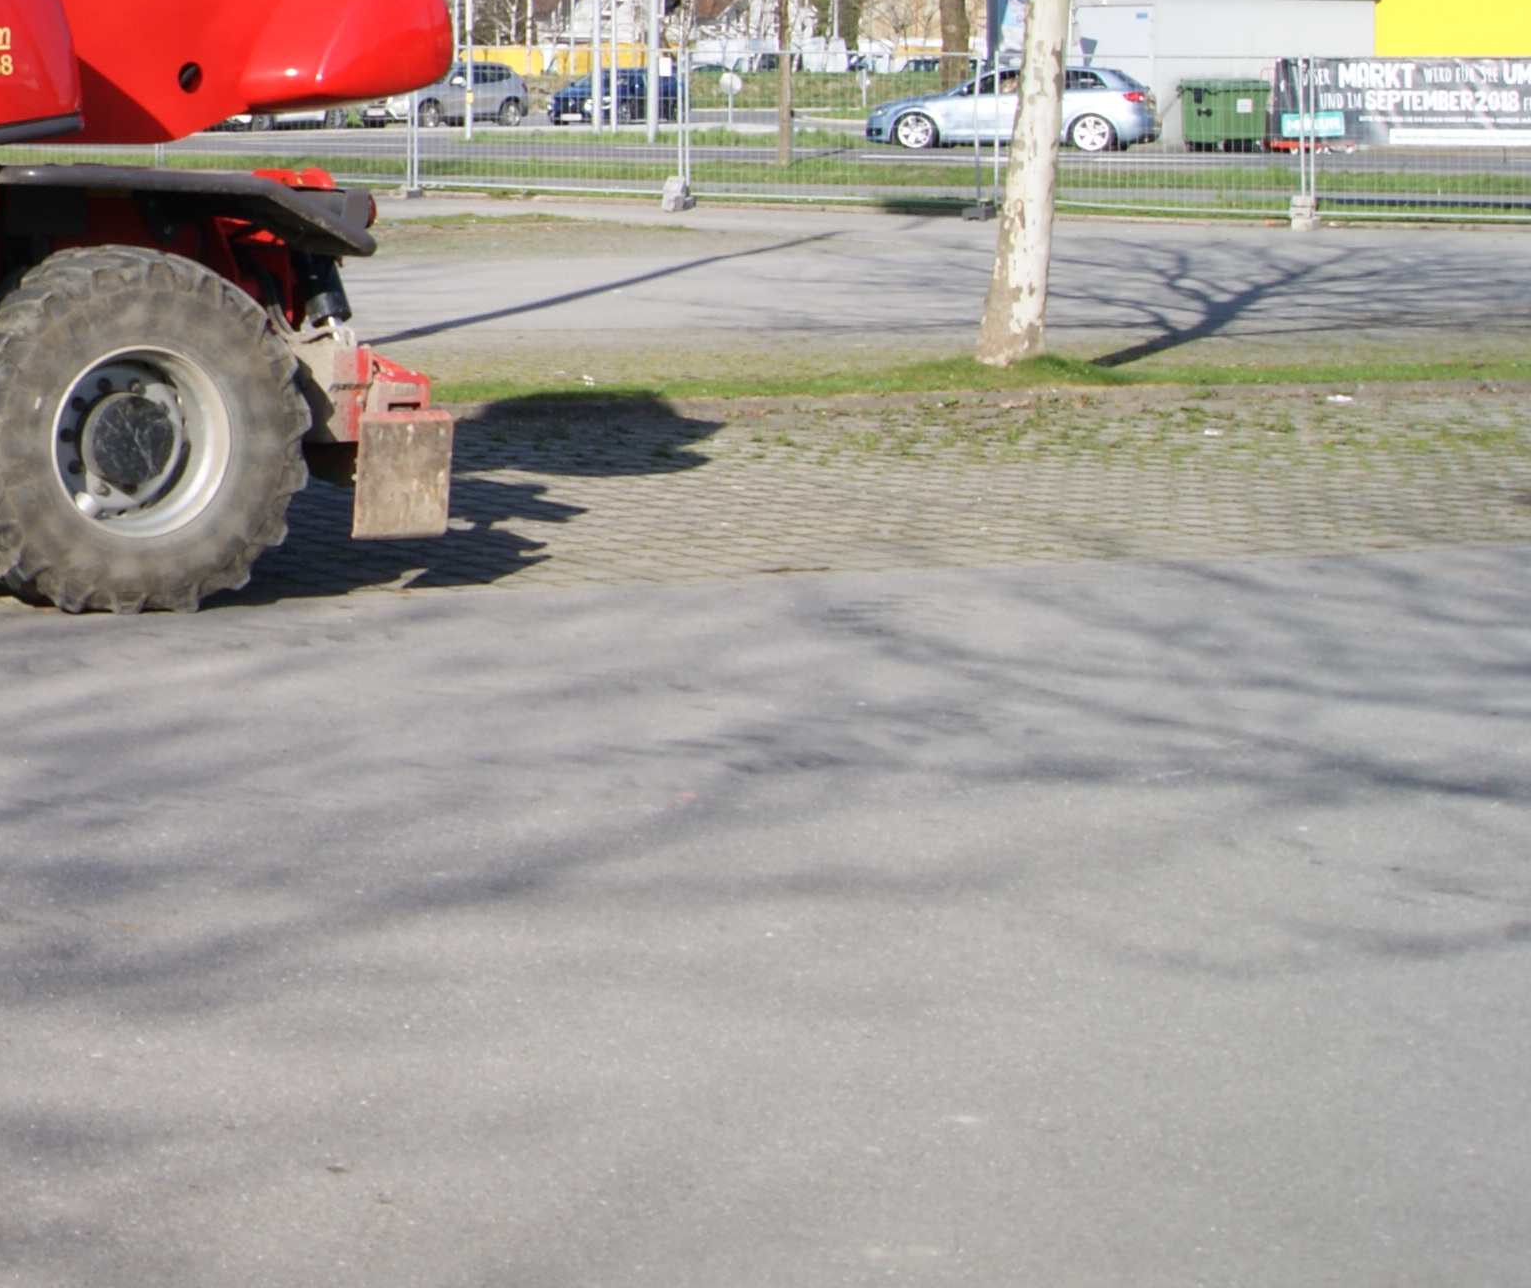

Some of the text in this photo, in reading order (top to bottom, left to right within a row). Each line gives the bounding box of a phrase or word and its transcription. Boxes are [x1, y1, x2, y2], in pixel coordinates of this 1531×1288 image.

[1338, 62, 1416, 89] MARKT
[1423, 66, 1452, 83] WIRD
[1319, 92, 1344, 110] UND
[1364, 90, 1474, 112] SEPTEMBER
[1474, 90, 1520, 112] 2018
